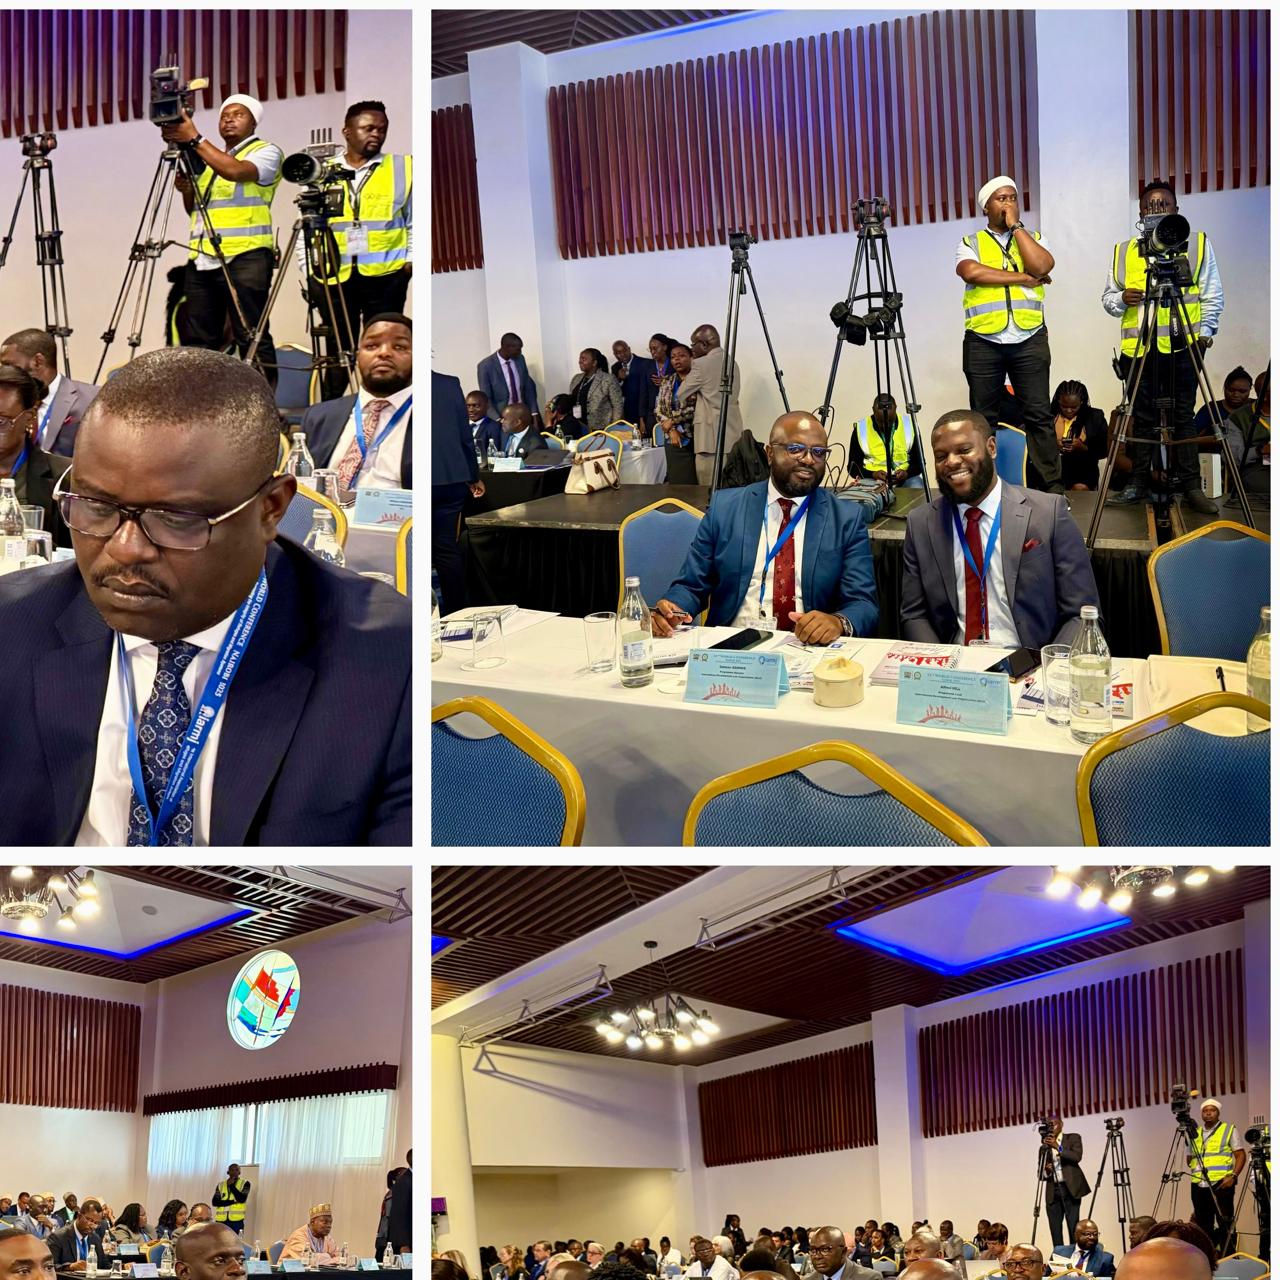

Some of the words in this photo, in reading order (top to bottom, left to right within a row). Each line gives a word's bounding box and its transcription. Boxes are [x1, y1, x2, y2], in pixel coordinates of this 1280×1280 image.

[238, 604, 260, 646] CONFERENCE
[222, 651, 240, 680] NAIROBI
[187, 715, 209, 744] iarmj
